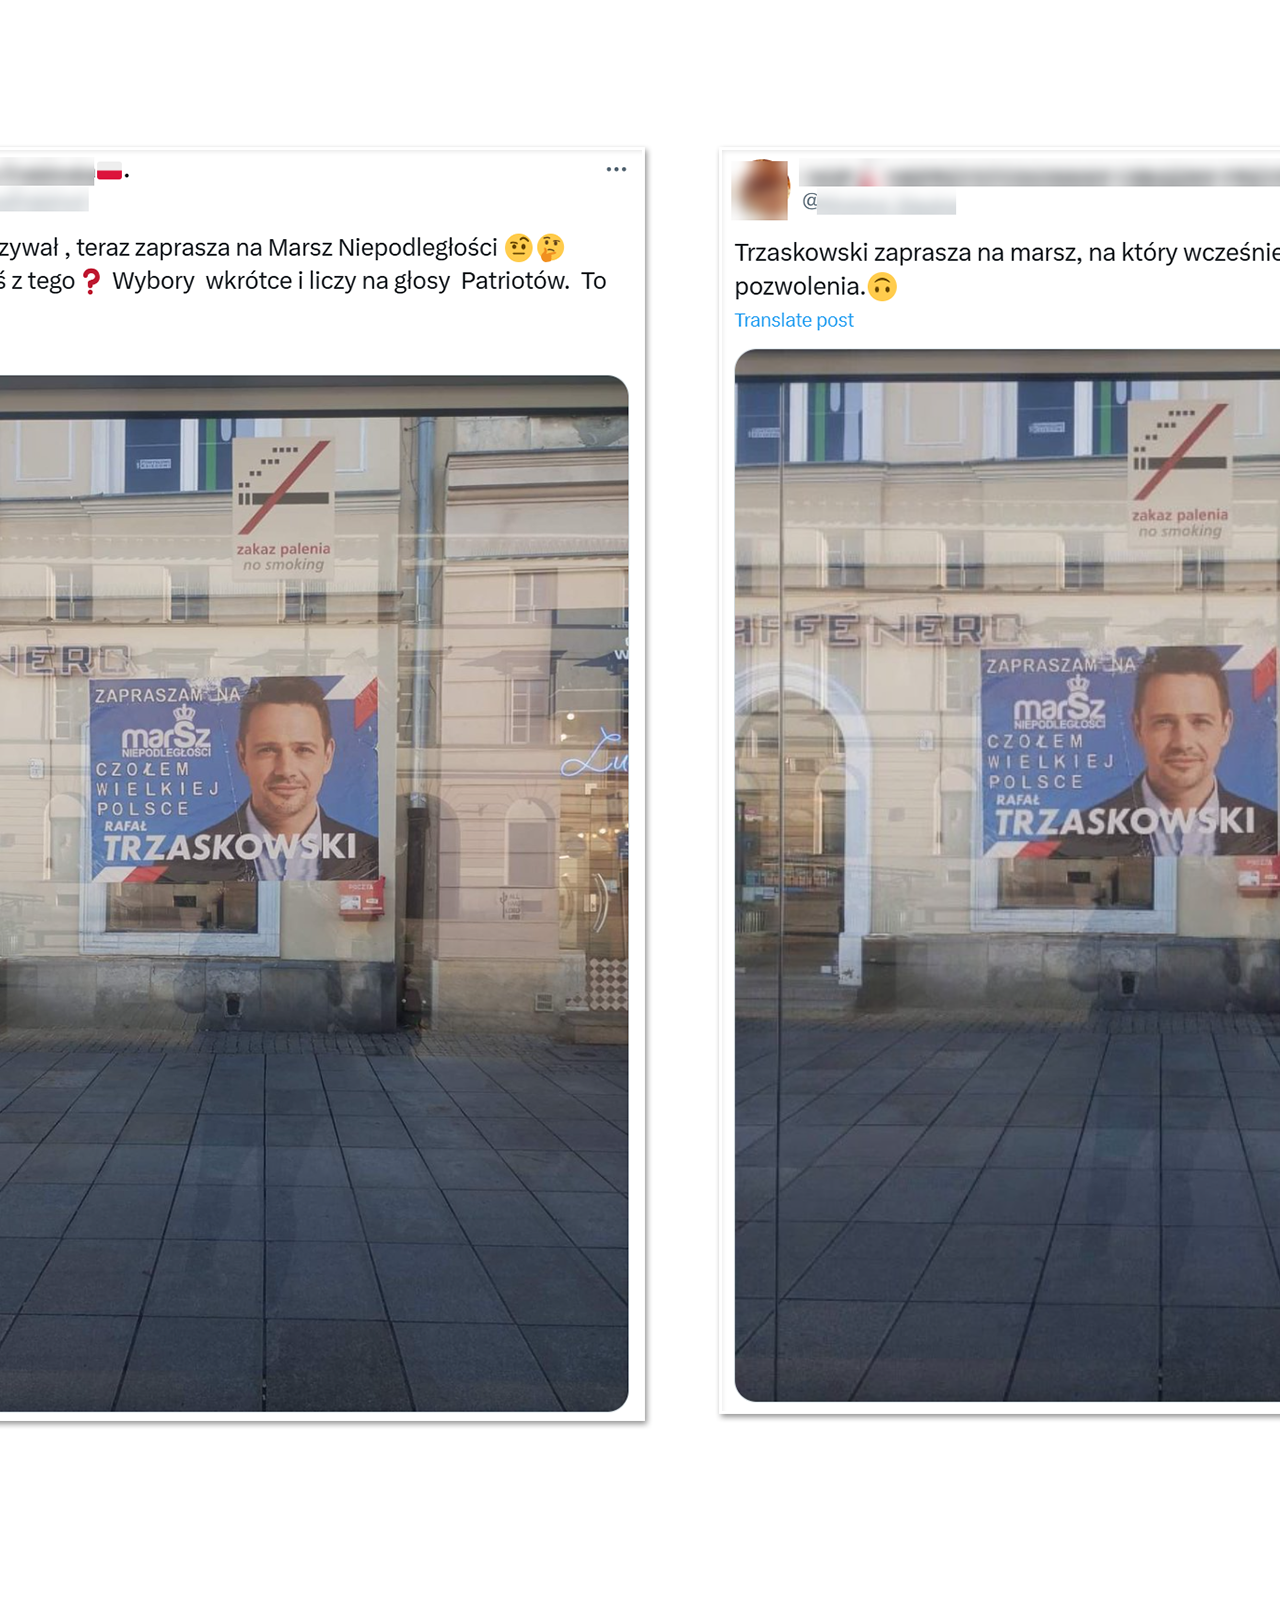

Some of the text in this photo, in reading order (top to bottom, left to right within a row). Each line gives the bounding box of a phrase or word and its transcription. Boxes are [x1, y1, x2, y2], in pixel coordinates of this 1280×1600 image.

[1131, 508, 1228, 523] zakaz palenia
[1139, 524, 1222, 539] no smoking
[236, 541, 331, 558] zakaz palenia
[243, 558, 325, 573] no smoking
[987, 657, 1137, 674] ZAPRASZAM NA
[95, 687, 241, 703] ZAPRASZAM NA
[987, 733, 1084, 749] CZOŁEM
[96, 762, 190, 777] CZOŁEM
[987, 753, 1114, 770] WIELKIEJ
[96, 780, 219, 797] WIELKIEJ
[989, 774, 1084, 790] POLSCE
[996, 793, 1041, 806] RAFAŁ
[97, 801, 189, 817] POLSCE
[104, 820, 148, 832] RAFAŁ
[995, 806, 1256, 836] TRZASKOWSKI
[103, 832, 357, 861] TRZASKOWSKI
